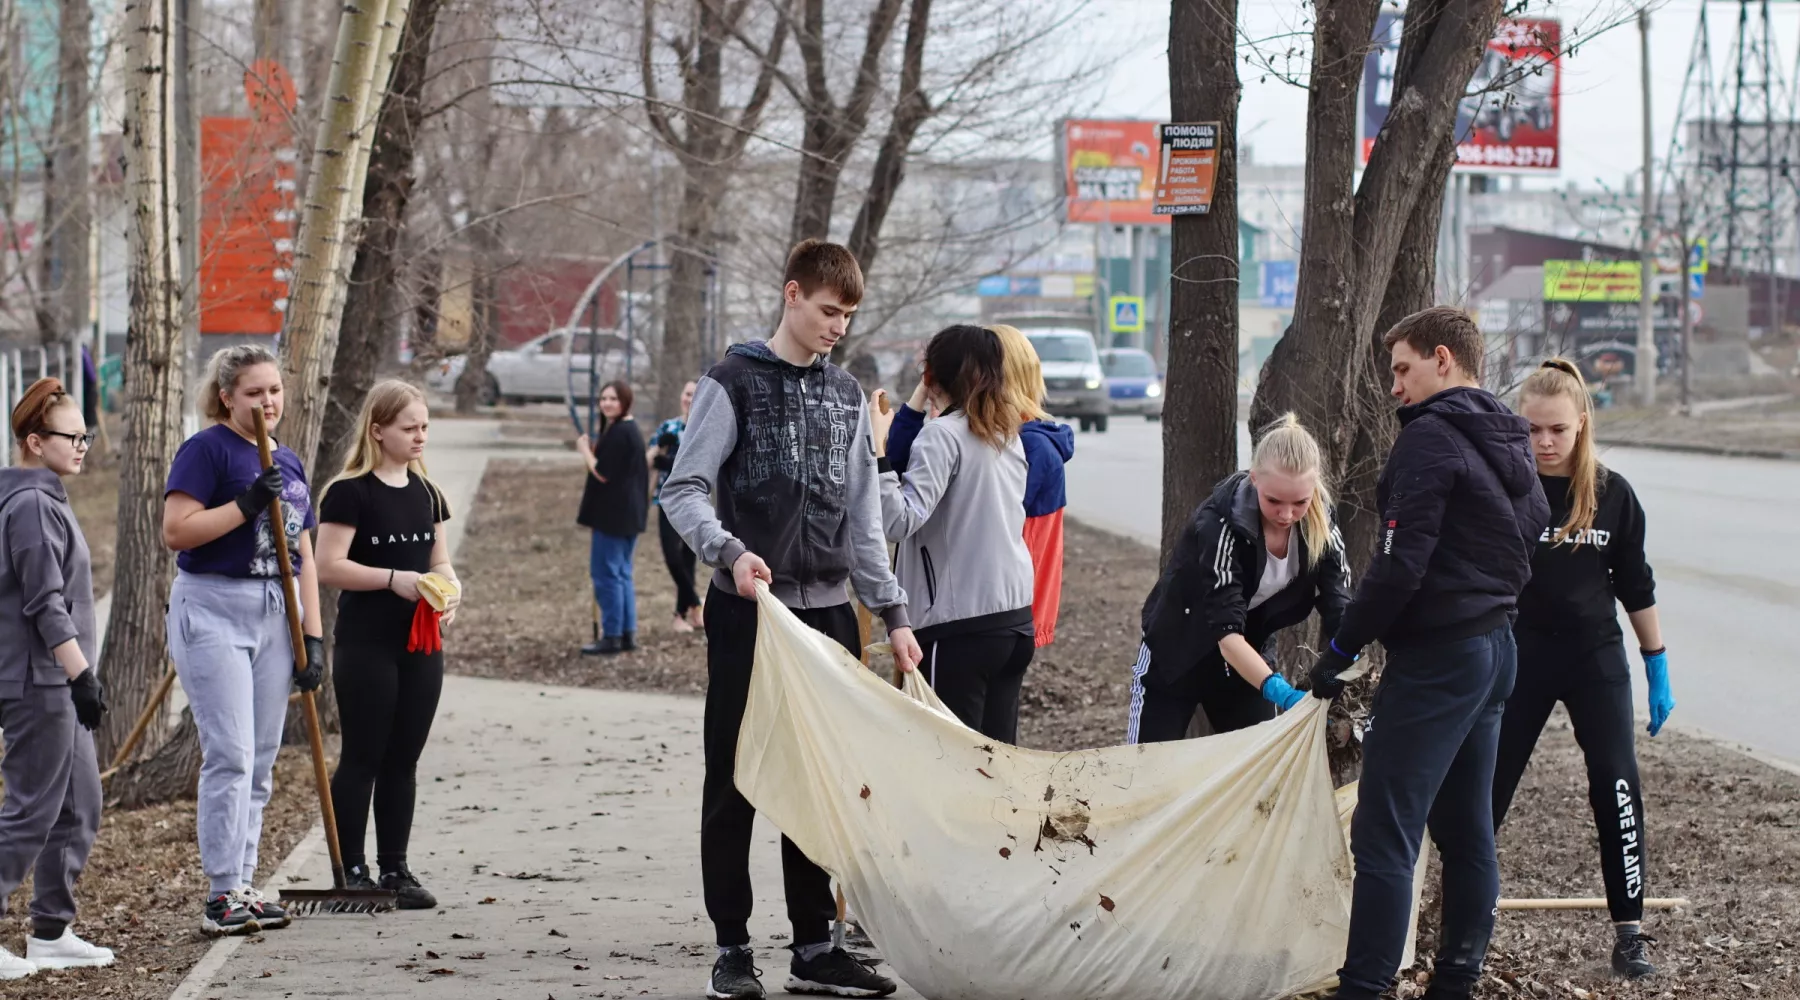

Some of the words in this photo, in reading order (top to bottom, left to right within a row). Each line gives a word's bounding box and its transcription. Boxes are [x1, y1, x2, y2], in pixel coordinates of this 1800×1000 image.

[1165, 126, 1214, 137] ПОМОЩЬ
[1172, 138, 1214, 149] ЛЮДЯМ
[1169, 176, 1198, 184] ПИТАНИЕ
[828, 408, 848, 484] USED
[1383, 529, 1394, 555] SNOW
[1615, 778, 1636, 830] CARE
[1621, 830, 1641, 899] PLANTS
